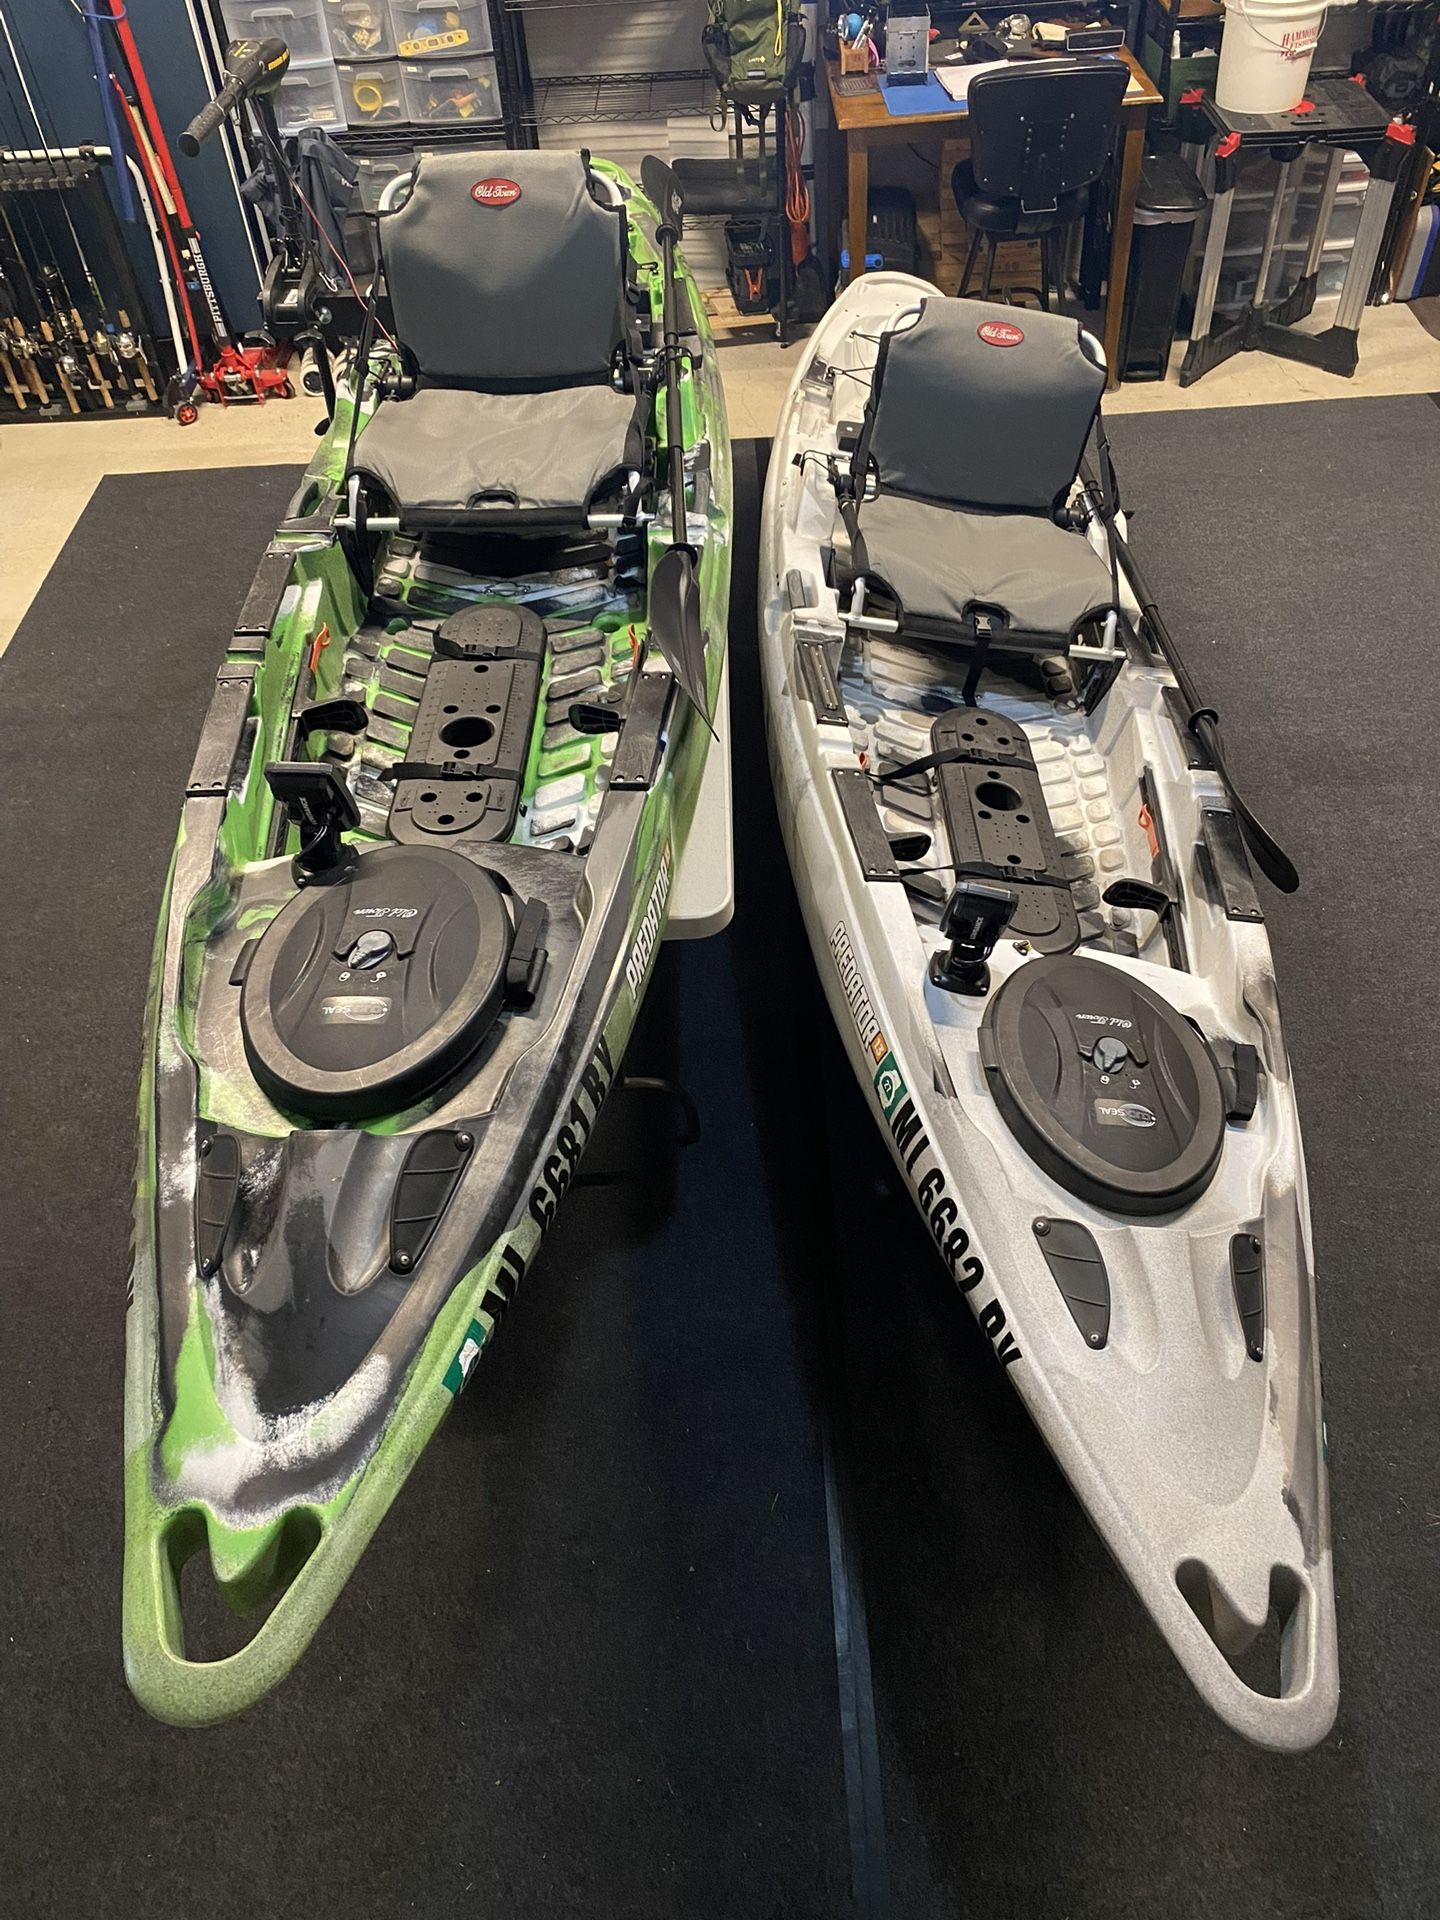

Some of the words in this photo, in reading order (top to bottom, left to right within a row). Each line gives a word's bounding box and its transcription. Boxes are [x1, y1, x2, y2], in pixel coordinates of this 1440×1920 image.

[475, 185, 493, 198] Old
[492, 185, 518, 198] Town
[194, 253, 223, 324] PITTSBURGH
[981, 325, 999, 338] Old
[387, 907, 419, 919] Old
[625, 855, 671, 1001] PREDATOR
[829, 920, 881, 1054] PREDATOR
[1108, 1017, 1133, 1029] Old
[890, 1097, 931, 1178] MI
[917, 1167, 985, 1294] 6682
